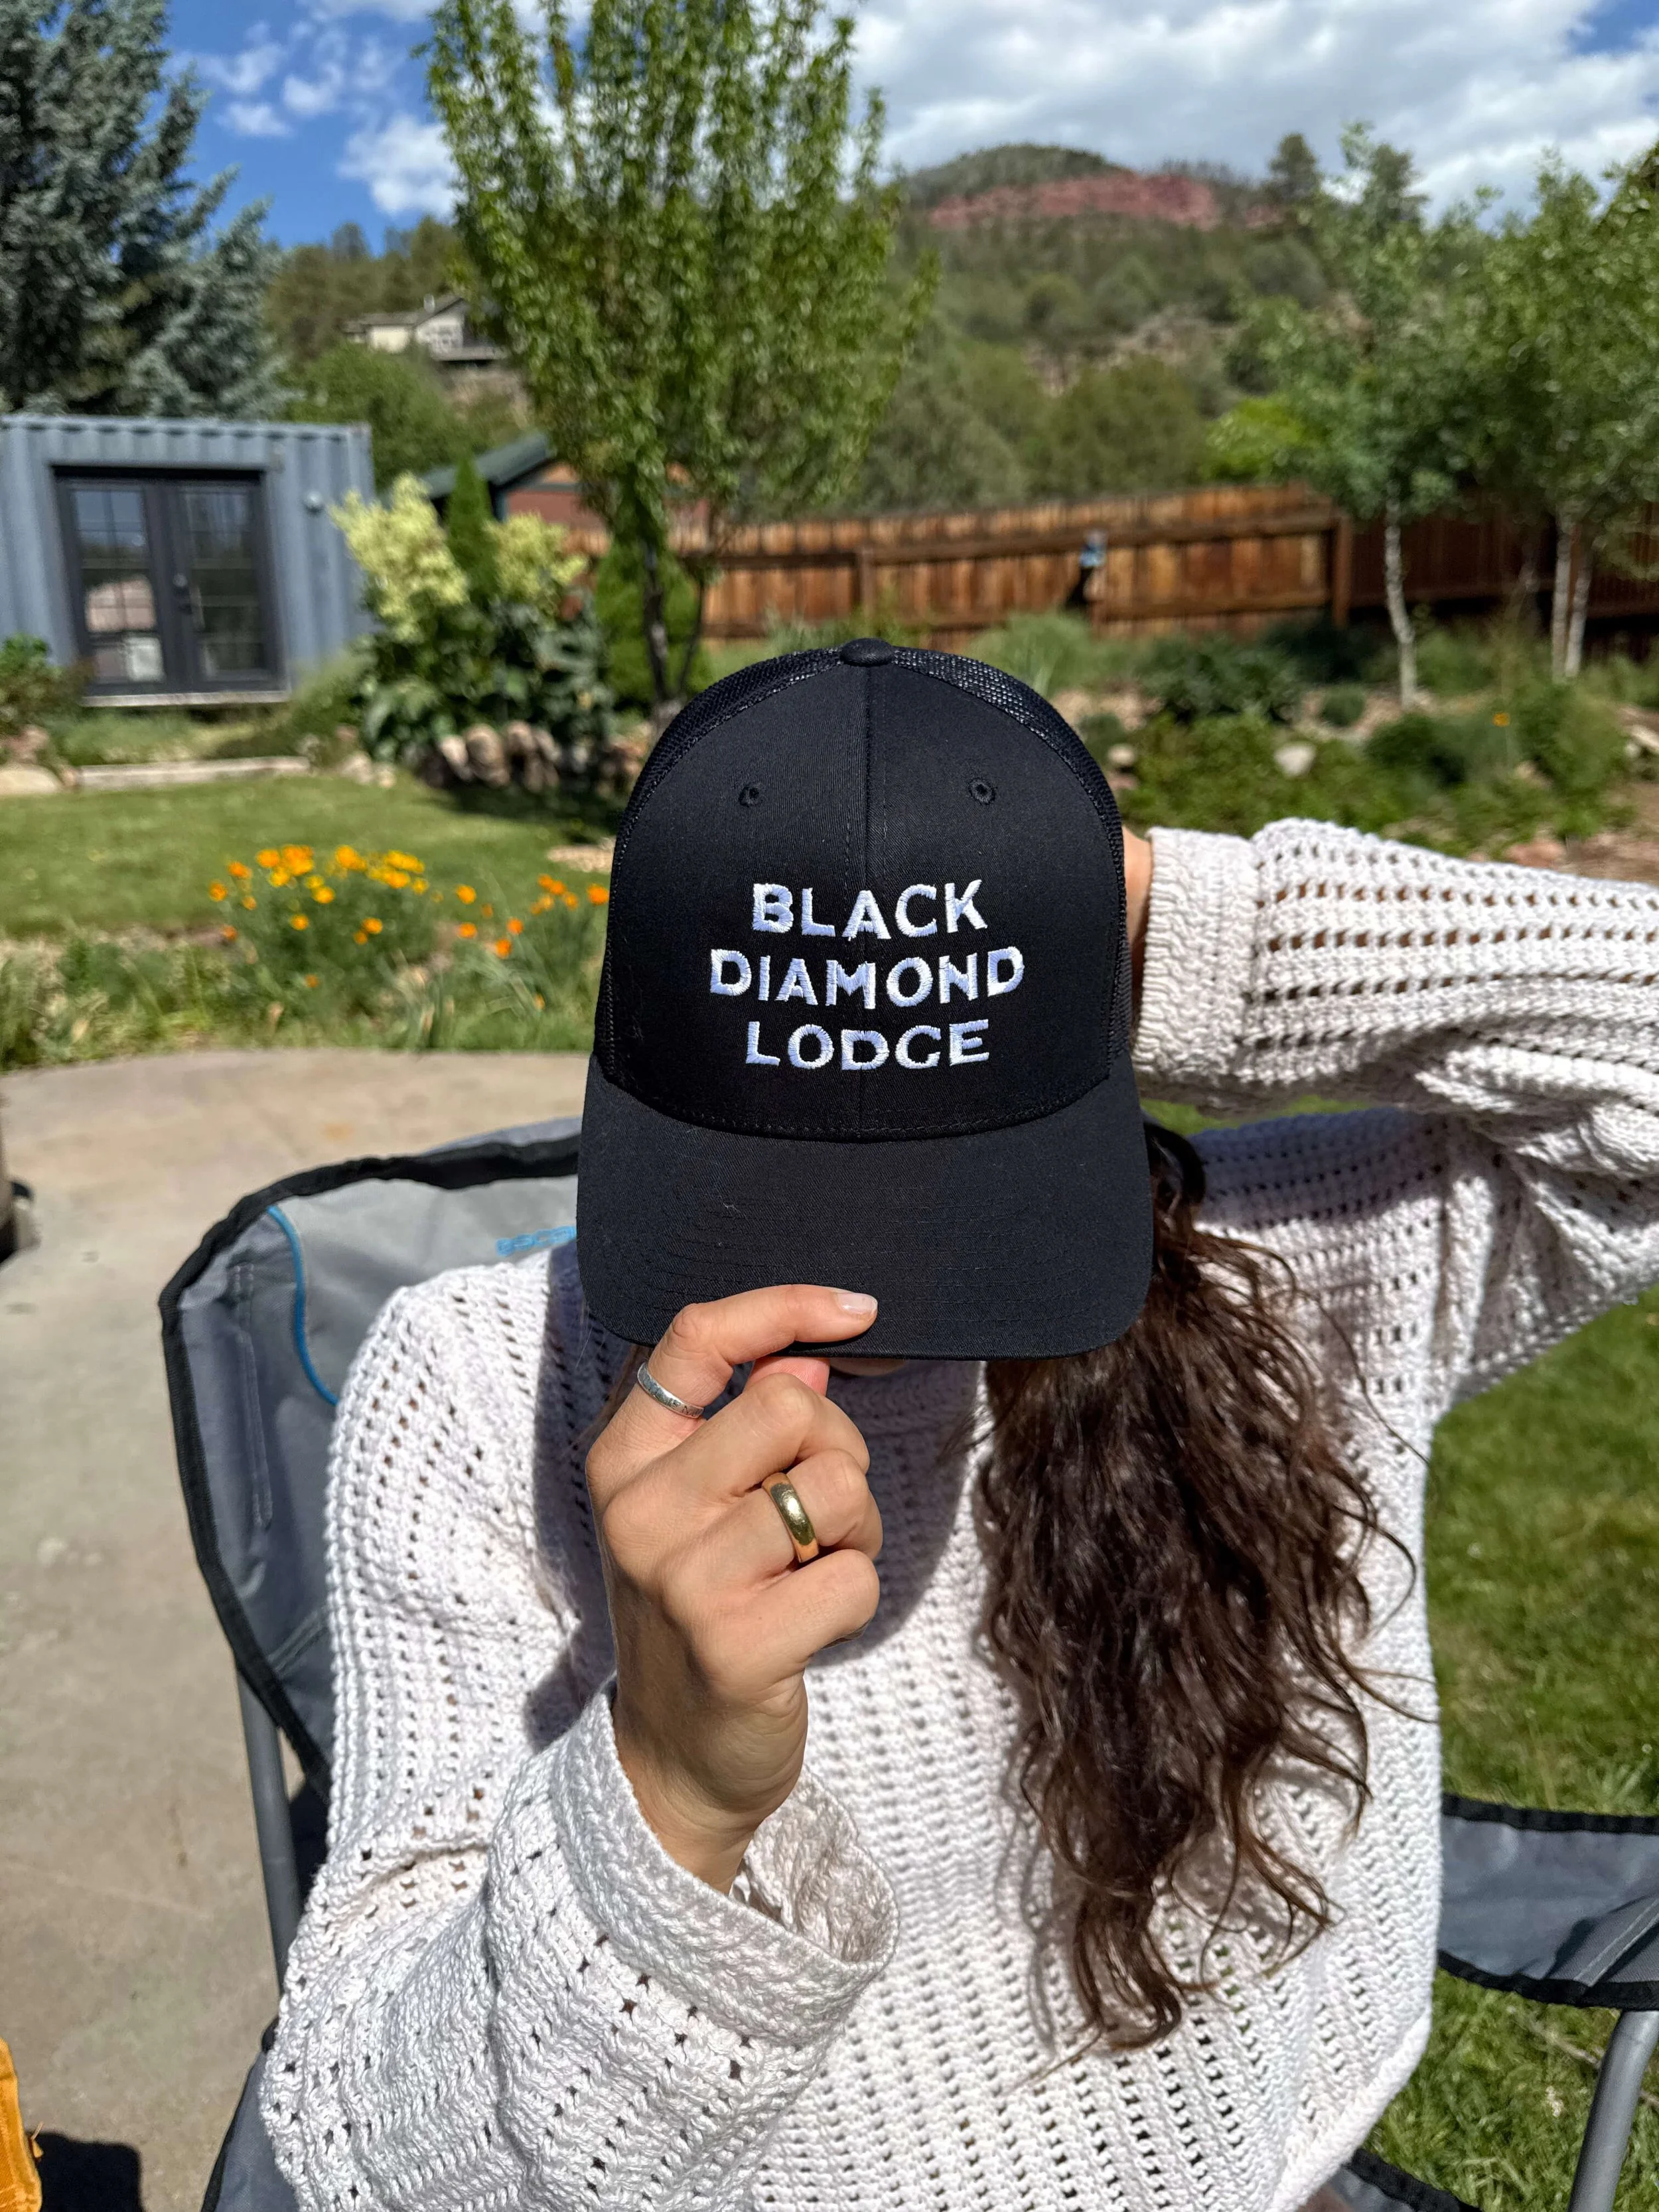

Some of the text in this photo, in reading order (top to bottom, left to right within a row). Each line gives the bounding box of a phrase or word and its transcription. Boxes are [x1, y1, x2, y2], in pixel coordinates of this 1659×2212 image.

[751, 879, 988, 941] BLACK
[709, 946, 1025, 1010] DIAMOND
[745, 1019, 990, 1070] LODGE
